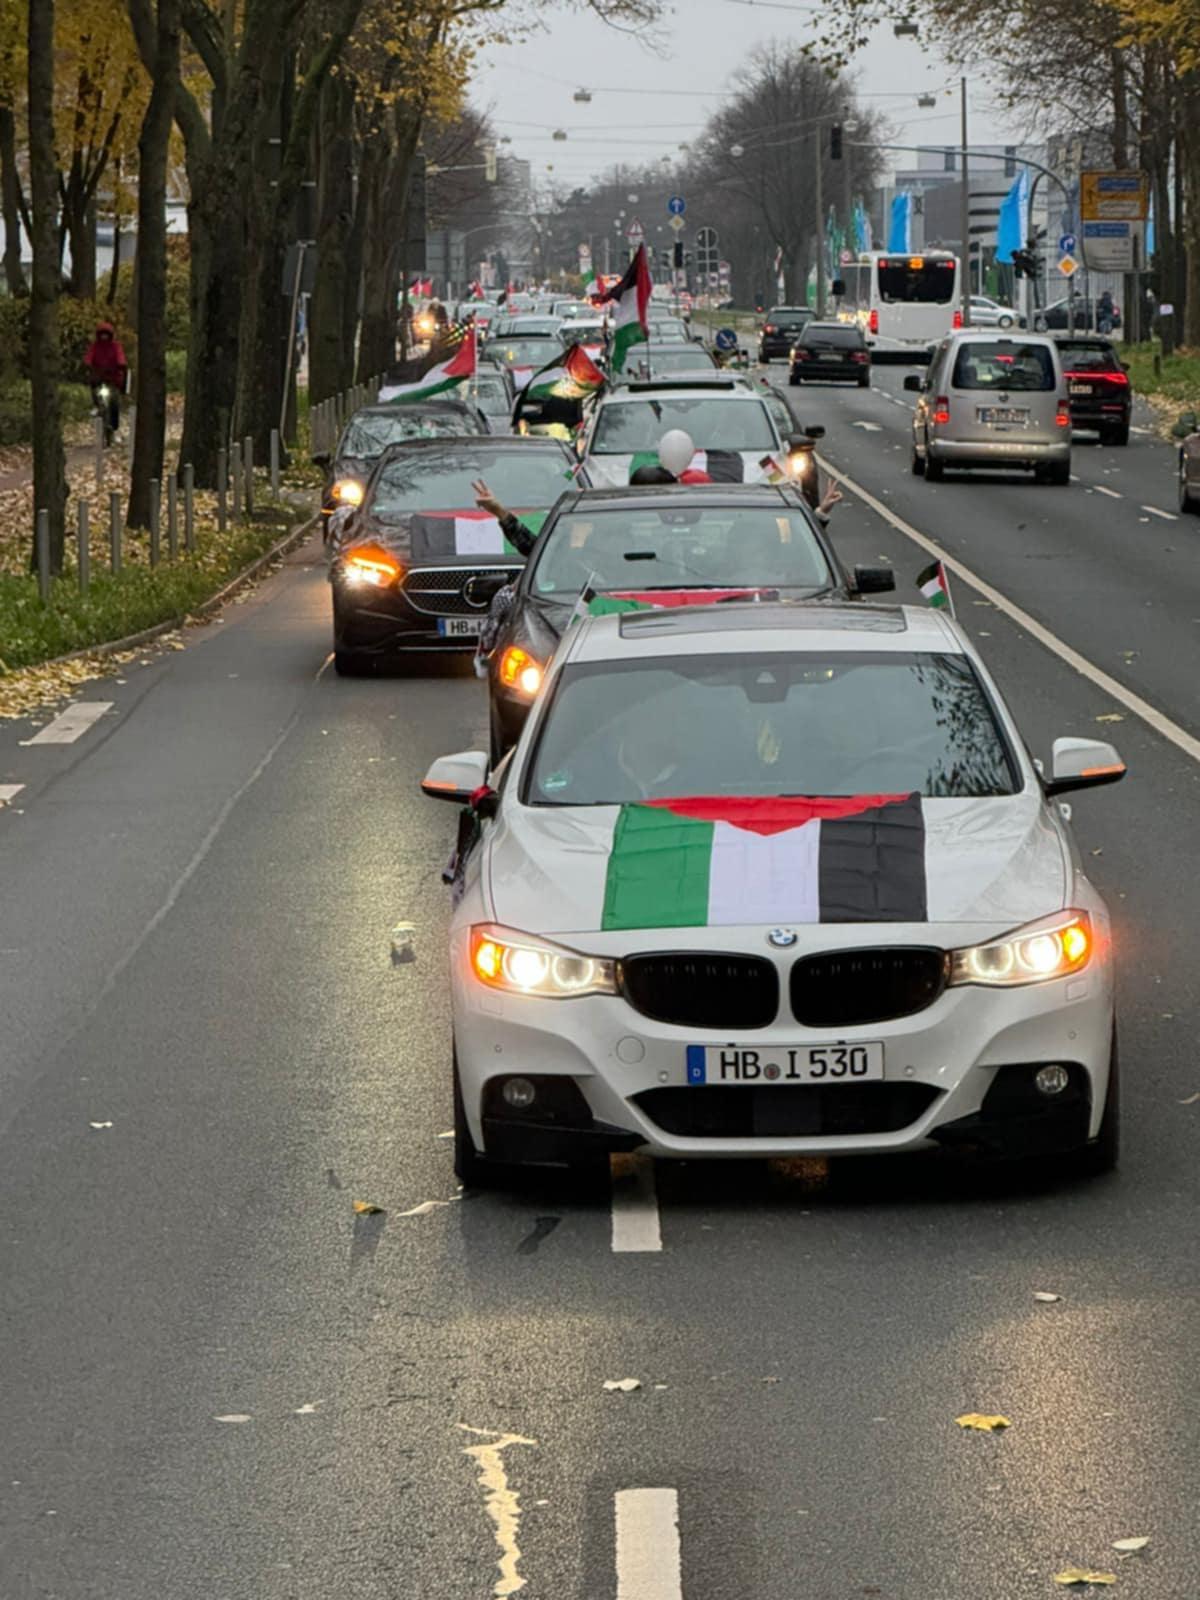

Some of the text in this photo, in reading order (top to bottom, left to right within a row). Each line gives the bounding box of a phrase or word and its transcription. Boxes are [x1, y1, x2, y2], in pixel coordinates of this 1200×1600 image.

[450, 621, 469, 634] HB
[720, 1047, 868, 1079] HB I 530
